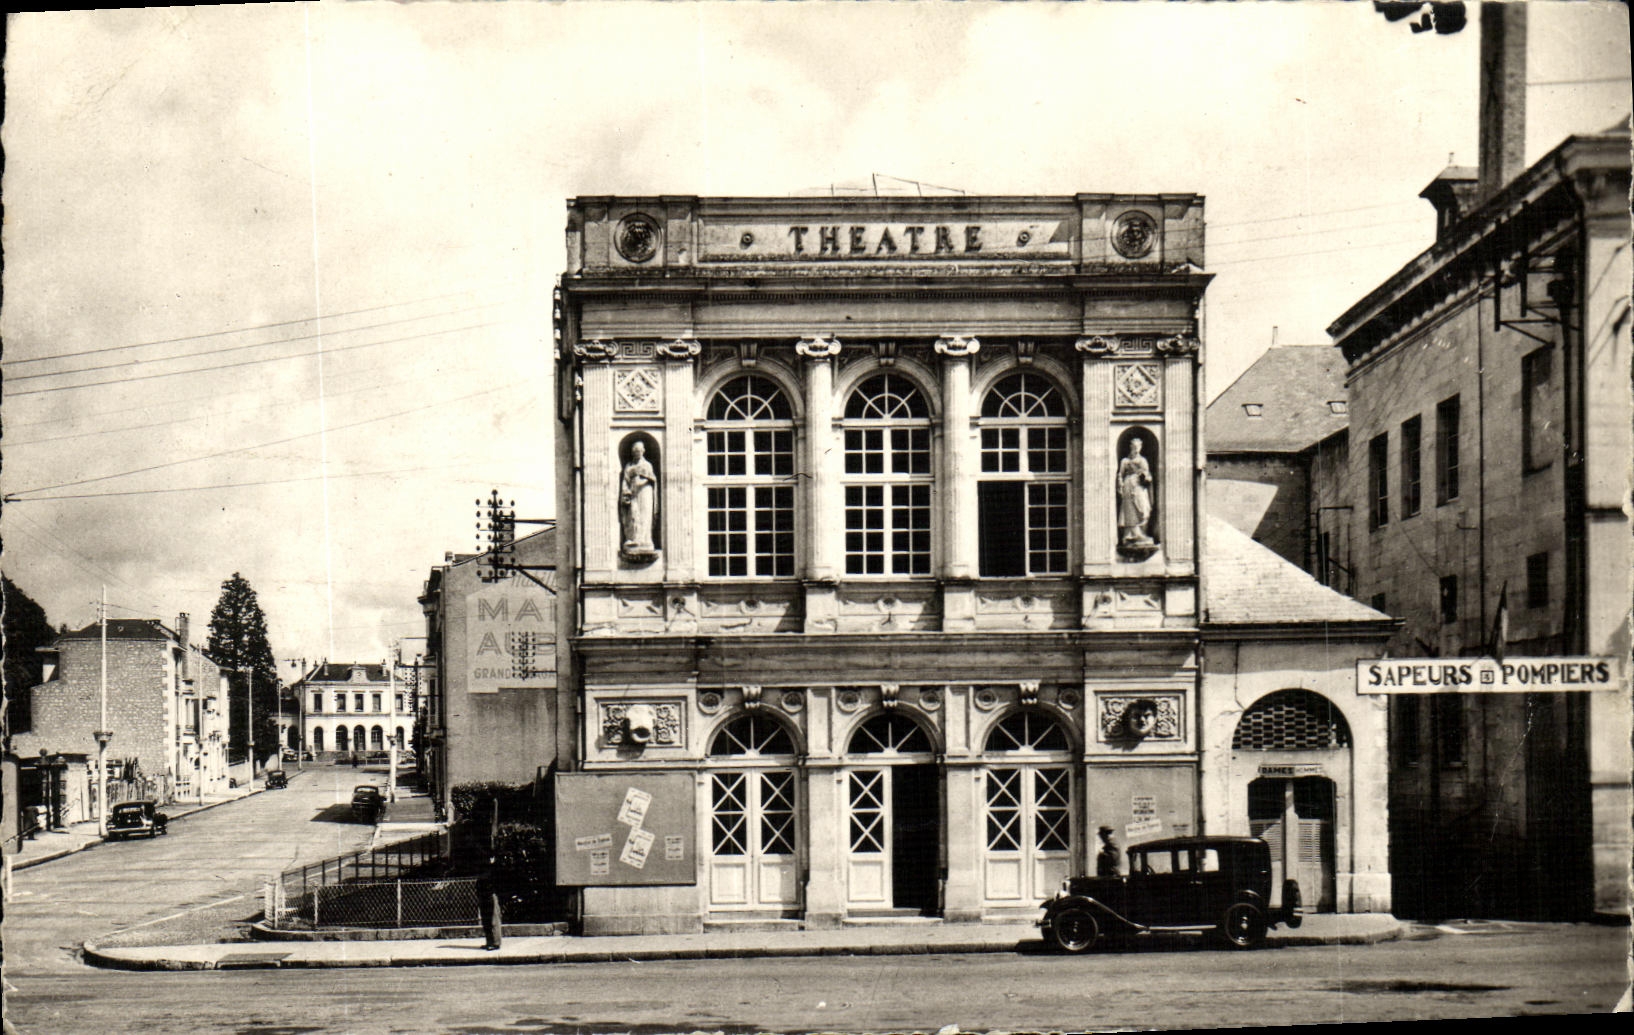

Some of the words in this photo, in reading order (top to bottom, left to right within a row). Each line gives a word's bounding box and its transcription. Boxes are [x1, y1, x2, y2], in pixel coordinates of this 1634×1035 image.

[788, 226, 984, 254] THEATRE
[1368, 664, 1473, 686] SAPEURS
[1502, 662, 1610, 685] POMPIERS
